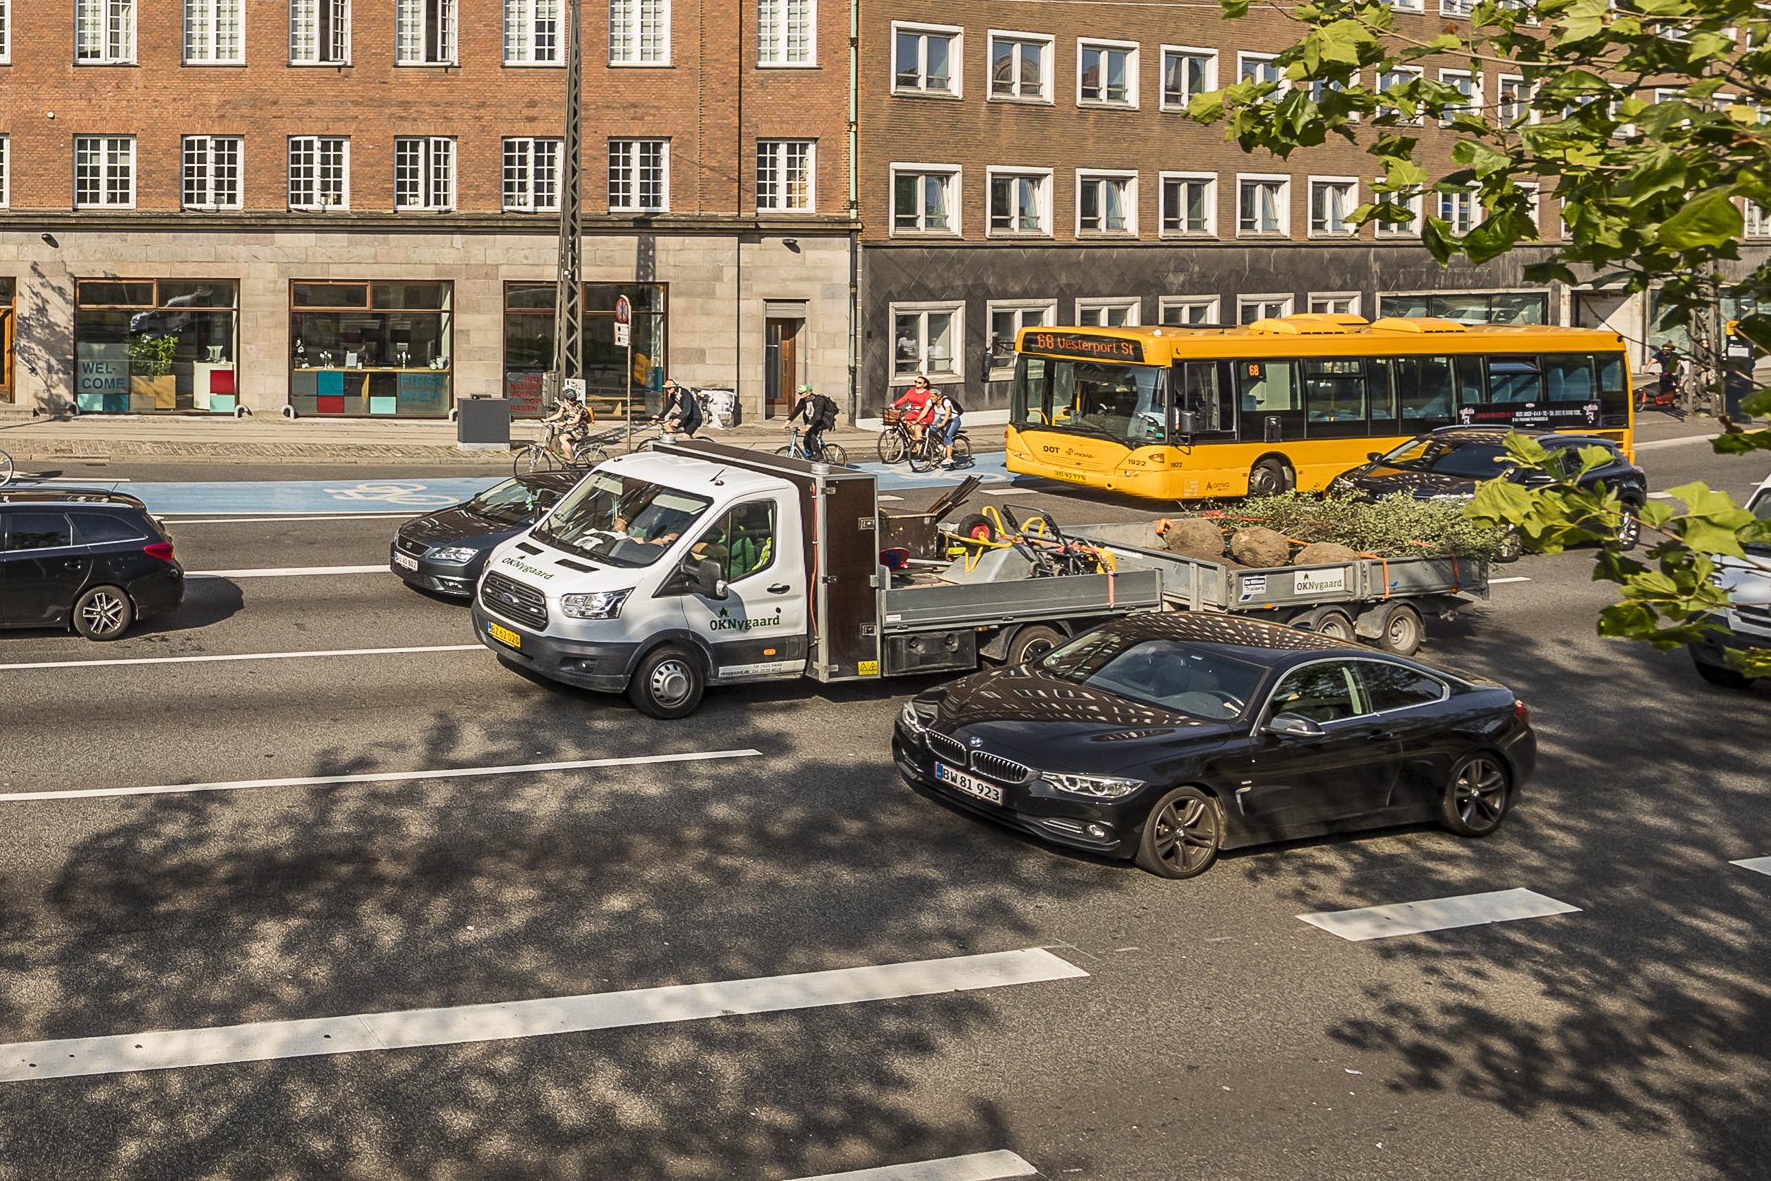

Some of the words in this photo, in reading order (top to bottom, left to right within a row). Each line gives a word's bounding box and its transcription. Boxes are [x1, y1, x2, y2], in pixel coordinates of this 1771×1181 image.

[1037, 333, 1055, 350] 68
[1120, 341, 1135, 356] St
[81, 362, 117, 374] WEL-
[1248, 364, 1260, 376] 68
[81, 377, 126, 390] COME
[400, 374, 445, 388] FIRST
[400, 390, 441, 403] STEP
[1043, 445, 1061, 454] DOT
[1127, 458, 1147, 467] 1922
[501, 557, 555, 580] OKNygaard
[1296, 579, 1342, 591] OKNygaard
[709, 614, 780, 631] OKNygaard
[499, 629, 507, 639] 62
[943, 768, 958, 784] BW
[959, 775, 973, 791] 81
[976, 783, 1000, 801] 923
